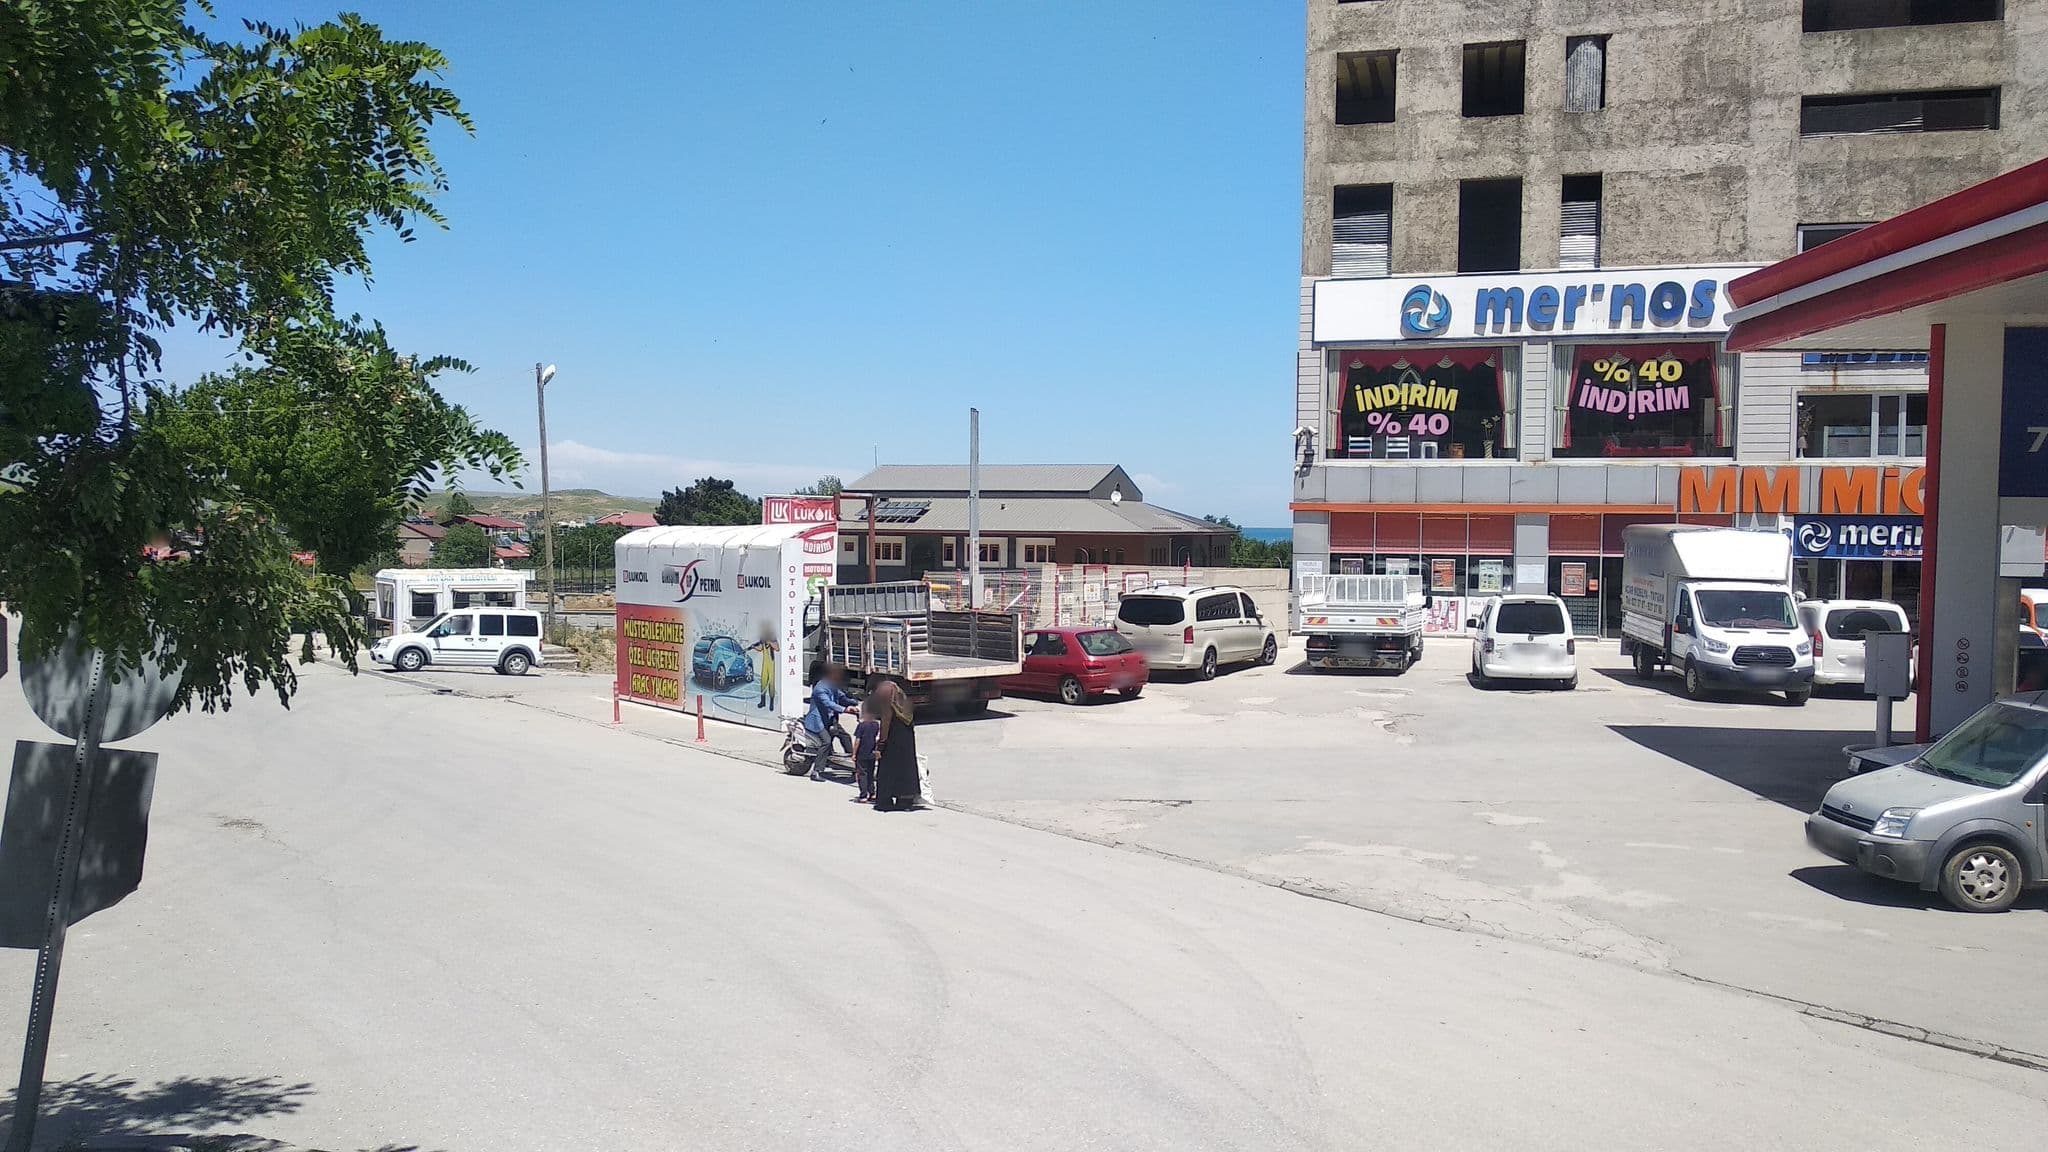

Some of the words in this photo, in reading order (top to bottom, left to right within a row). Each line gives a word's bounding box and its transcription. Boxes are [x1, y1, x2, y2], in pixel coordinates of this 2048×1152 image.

[1593, 359, 1630, 382] %
[1638, 360, 1683, 382] 40
[1367, 412, 1402, 435] %
[1408, 413, 1450, 435] 40
[794, 507, 834, 521] LUKOIL
[699, 578, 722, 593] PETROL
[744, 575, 771, 589] LUKOIL
